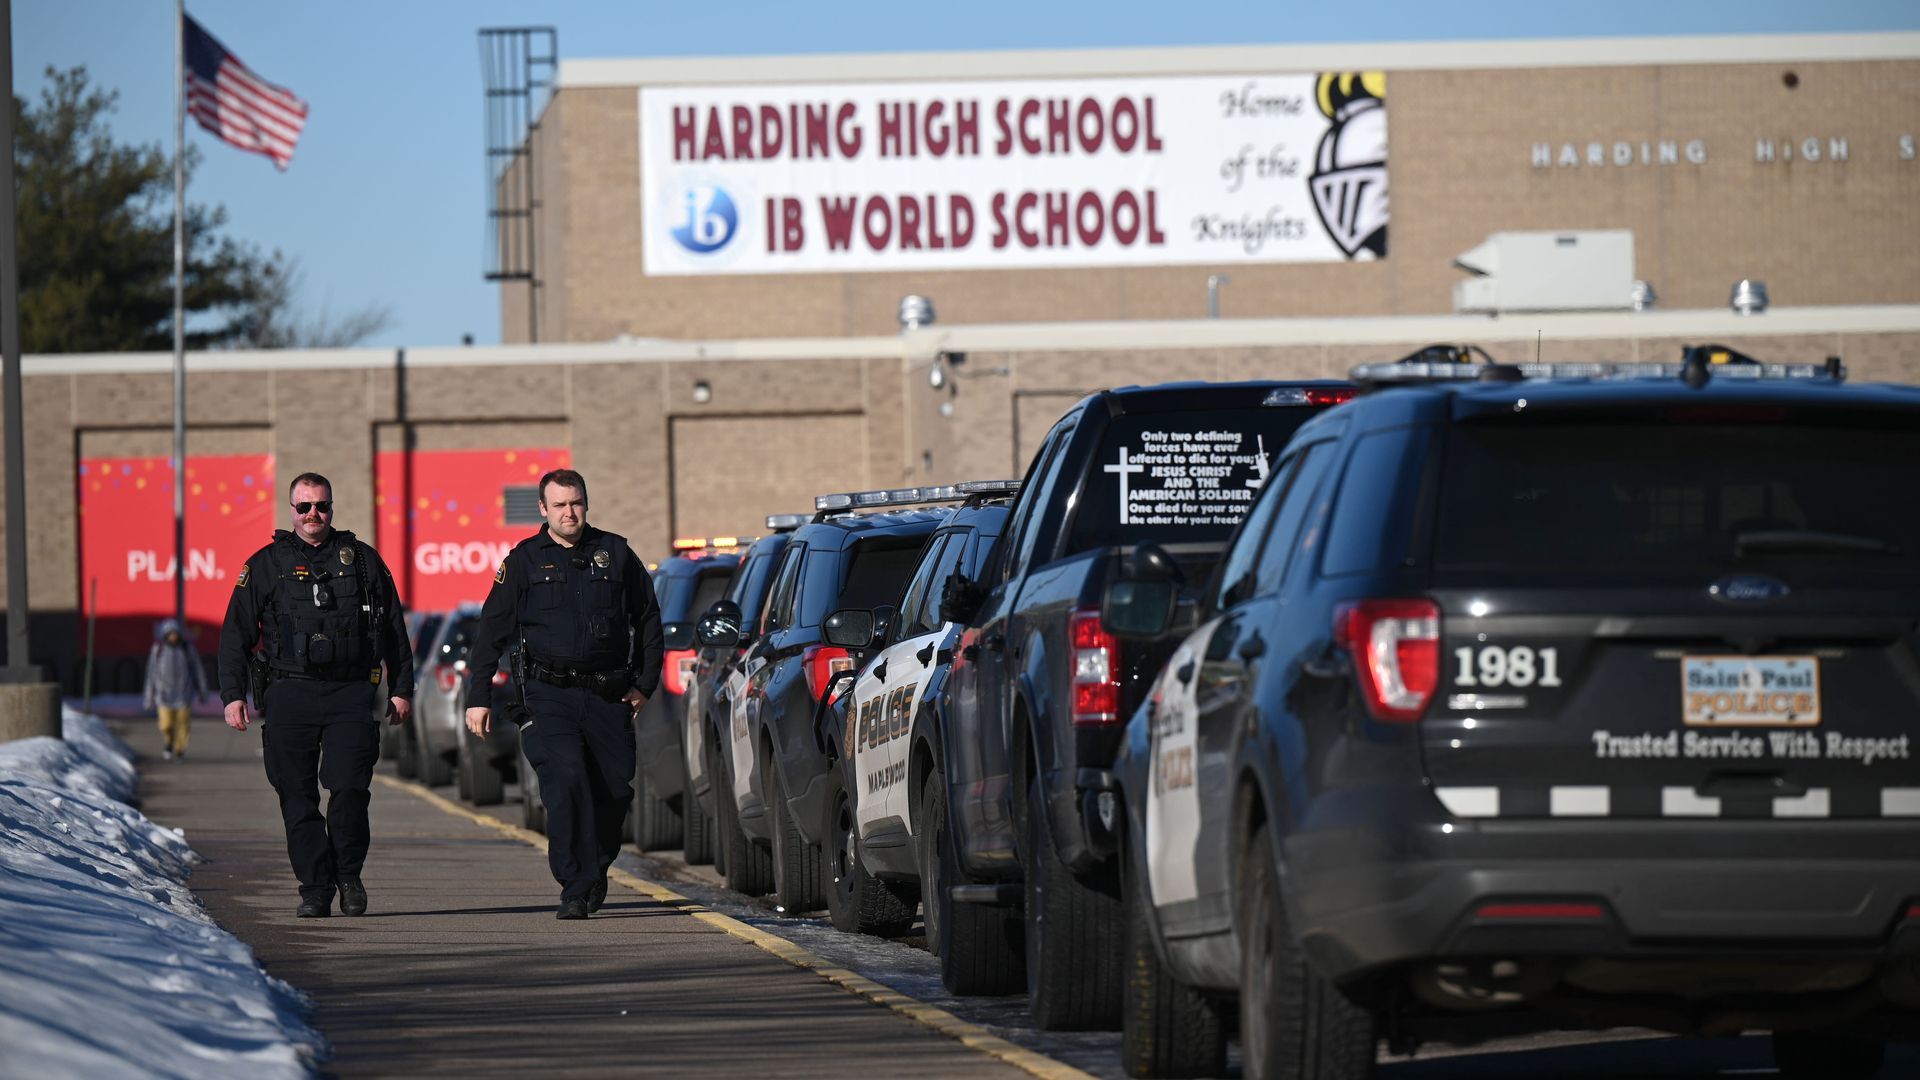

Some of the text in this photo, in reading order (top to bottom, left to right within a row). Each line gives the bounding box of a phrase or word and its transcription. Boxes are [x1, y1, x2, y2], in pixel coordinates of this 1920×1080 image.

[1219, 81, 1304, 118] Home
[673, 97, 1163, 161] HARDING HIGH SCHOOL
[1532, 140, 1707, 168] HARDING
[1756, 137, 1848, 162] HIGH
[1220, 142, 1299, 194] of the
[766, 190, 1165, 252] IB WORLD SCHOOL
[1191, 204, 1307, 256] Knights
[1141, 430, 1242, 443] Only two defining
[1144, 442, 1239, 452] forces have ever
[1129, 453, 1254, 465] offered to die for you;
[1151, 466, 1232, 477] JESUS CHRIST
[1163, 478, 1220, 488] AND THE
[1129, 489, 1195, 500] AMERICAN
[1129, 503, 1152, 513] One
[1154, 502, 1180, 513] died
[1182, 503, 1198, 513] for
[1200, 505, 1226, 515] your
[1129, 515, 1145, 524] the
[1146, 515, 1172, 524] other
[1173, 515, 1188, 524] for
[1189, 517, 1211, 525] your
[1726, 580, 1771, 599] Ford
[1454, 646, 1562, 687] 1981
[1688, 669, 1812, 688] Saint Paul
[1690, 691, 1812, 714] POLICE
[858, 682, 918, 754] POLICE
[1594, 730, 1910, 765] Trusted Service With Respect
[868, 758, 905, 795] MAPLEWOOD
